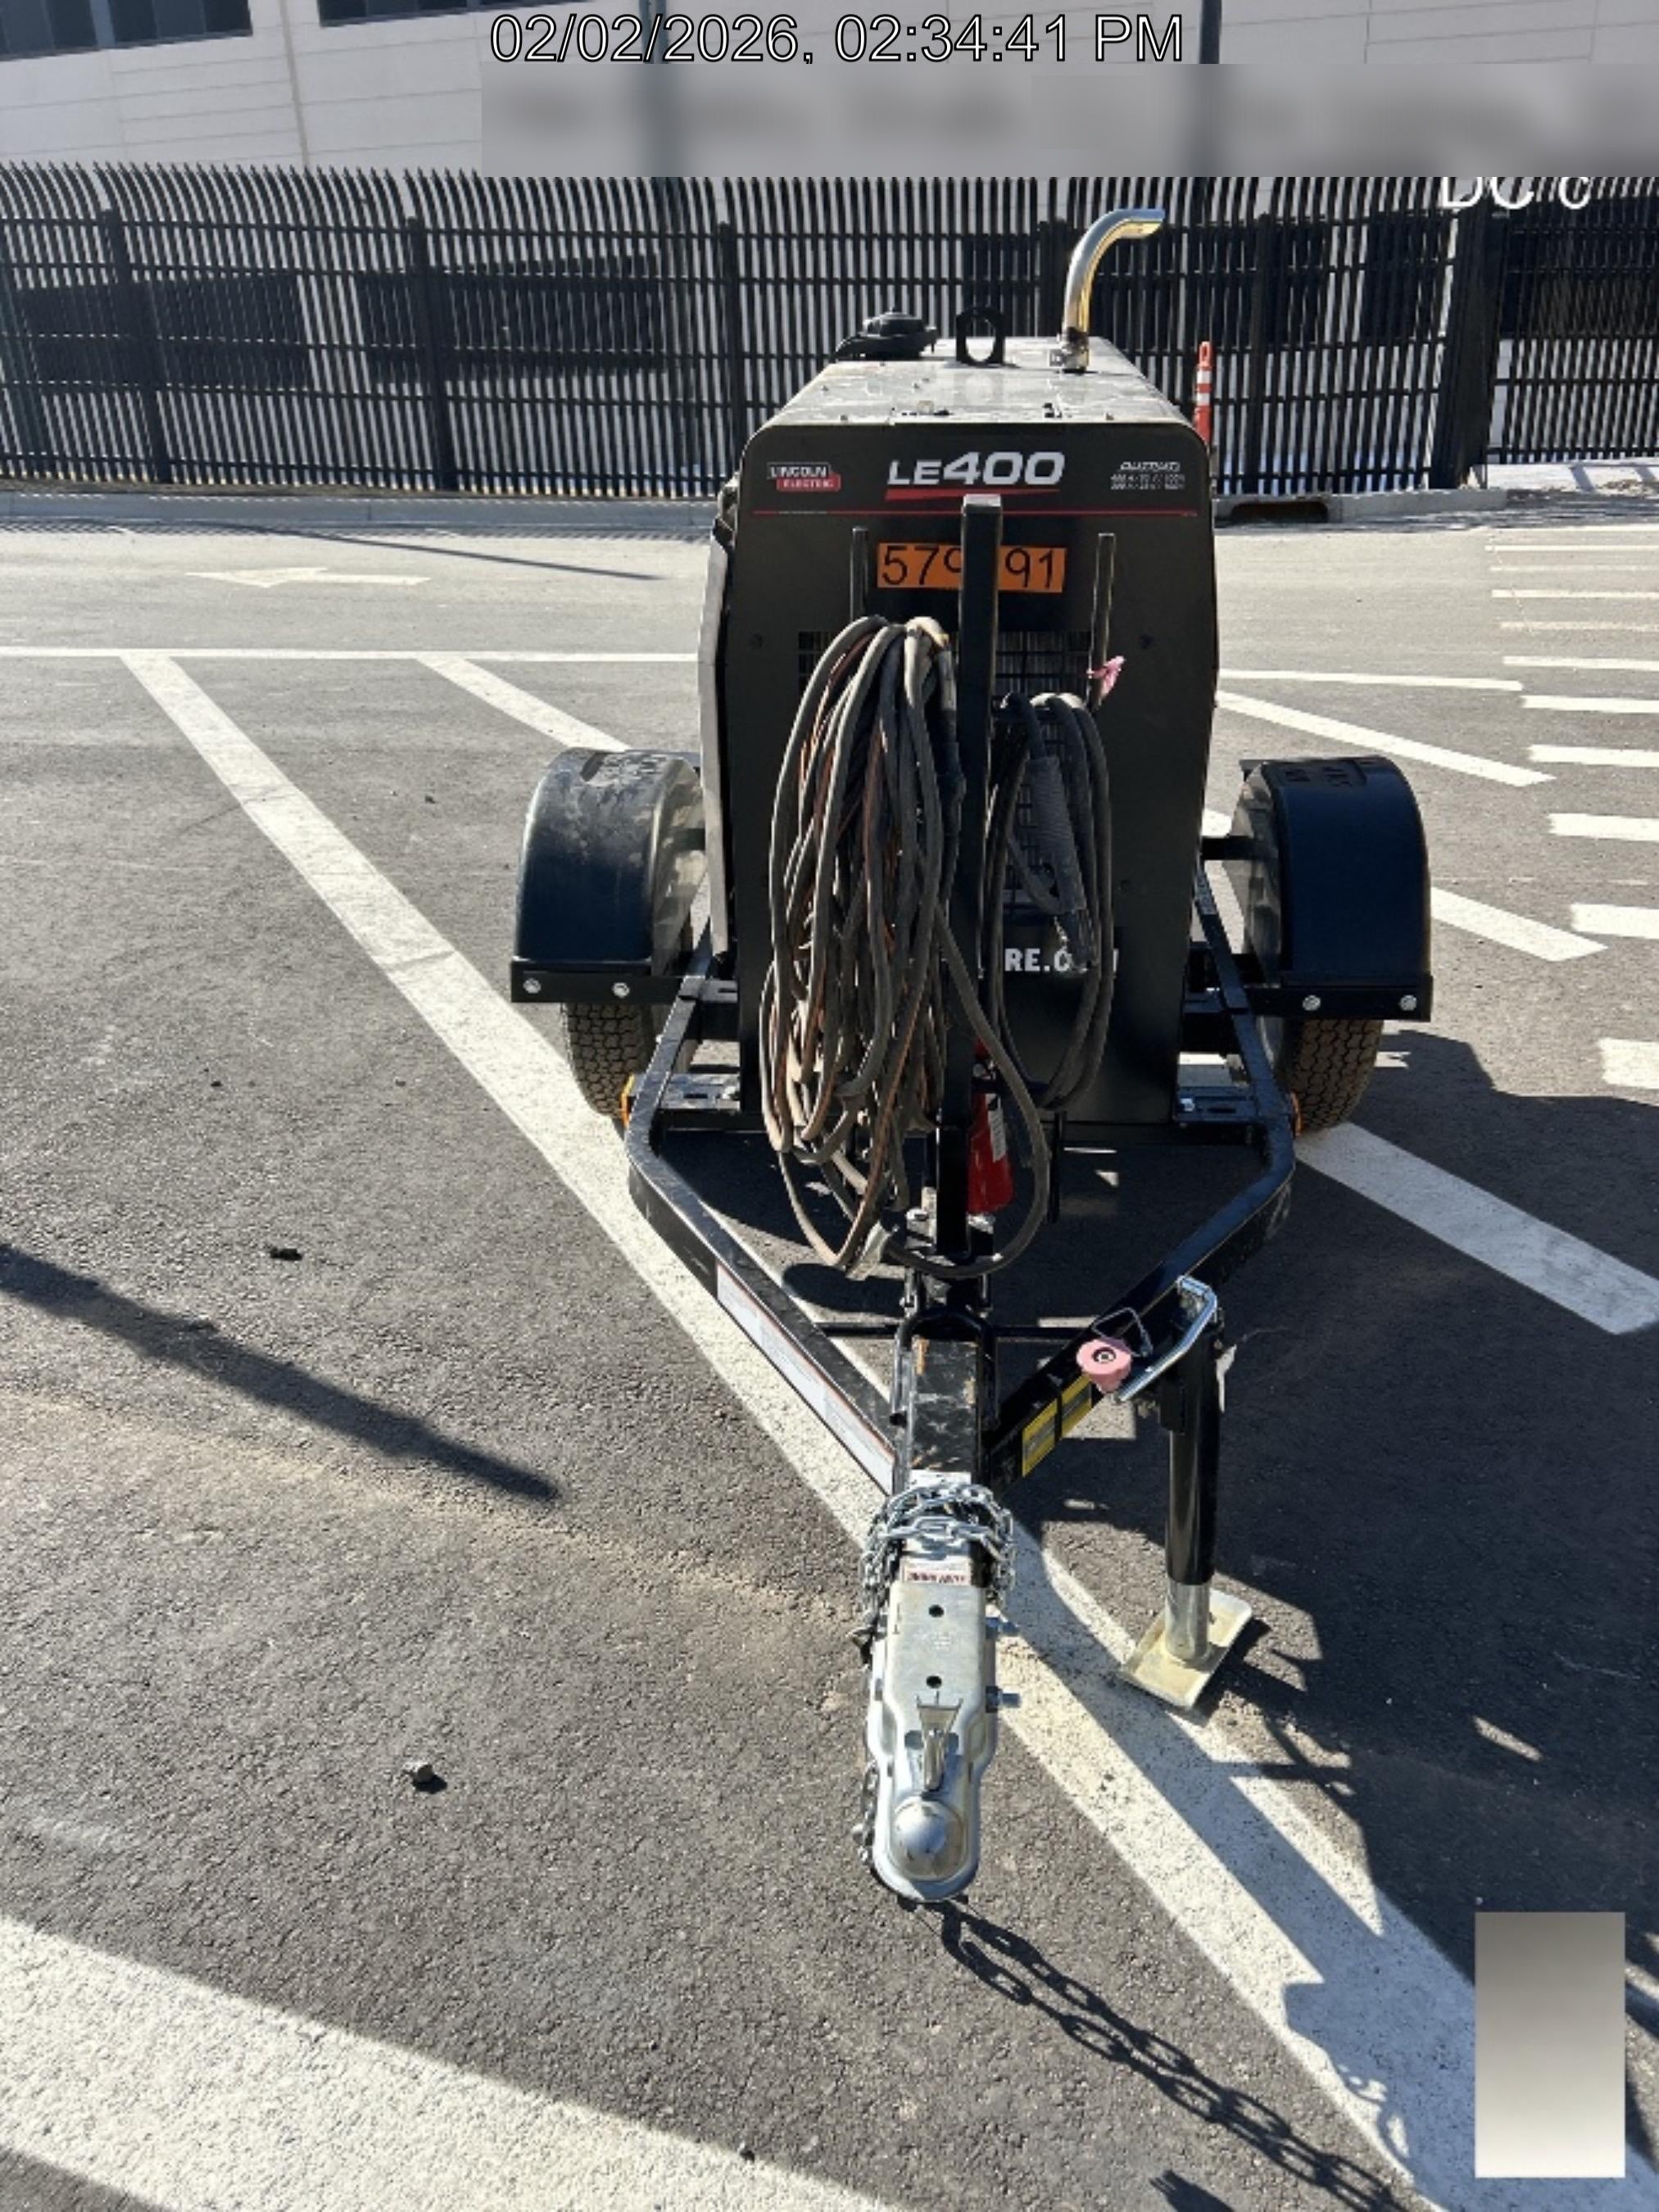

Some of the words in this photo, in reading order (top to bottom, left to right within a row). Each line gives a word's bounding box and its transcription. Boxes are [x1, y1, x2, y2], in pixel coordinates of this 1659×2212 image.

[770, 465, 827, 478] LINCOLN
[886, 451, 1065, 485] LE400
[882, 545, 1054, 588] 57991
